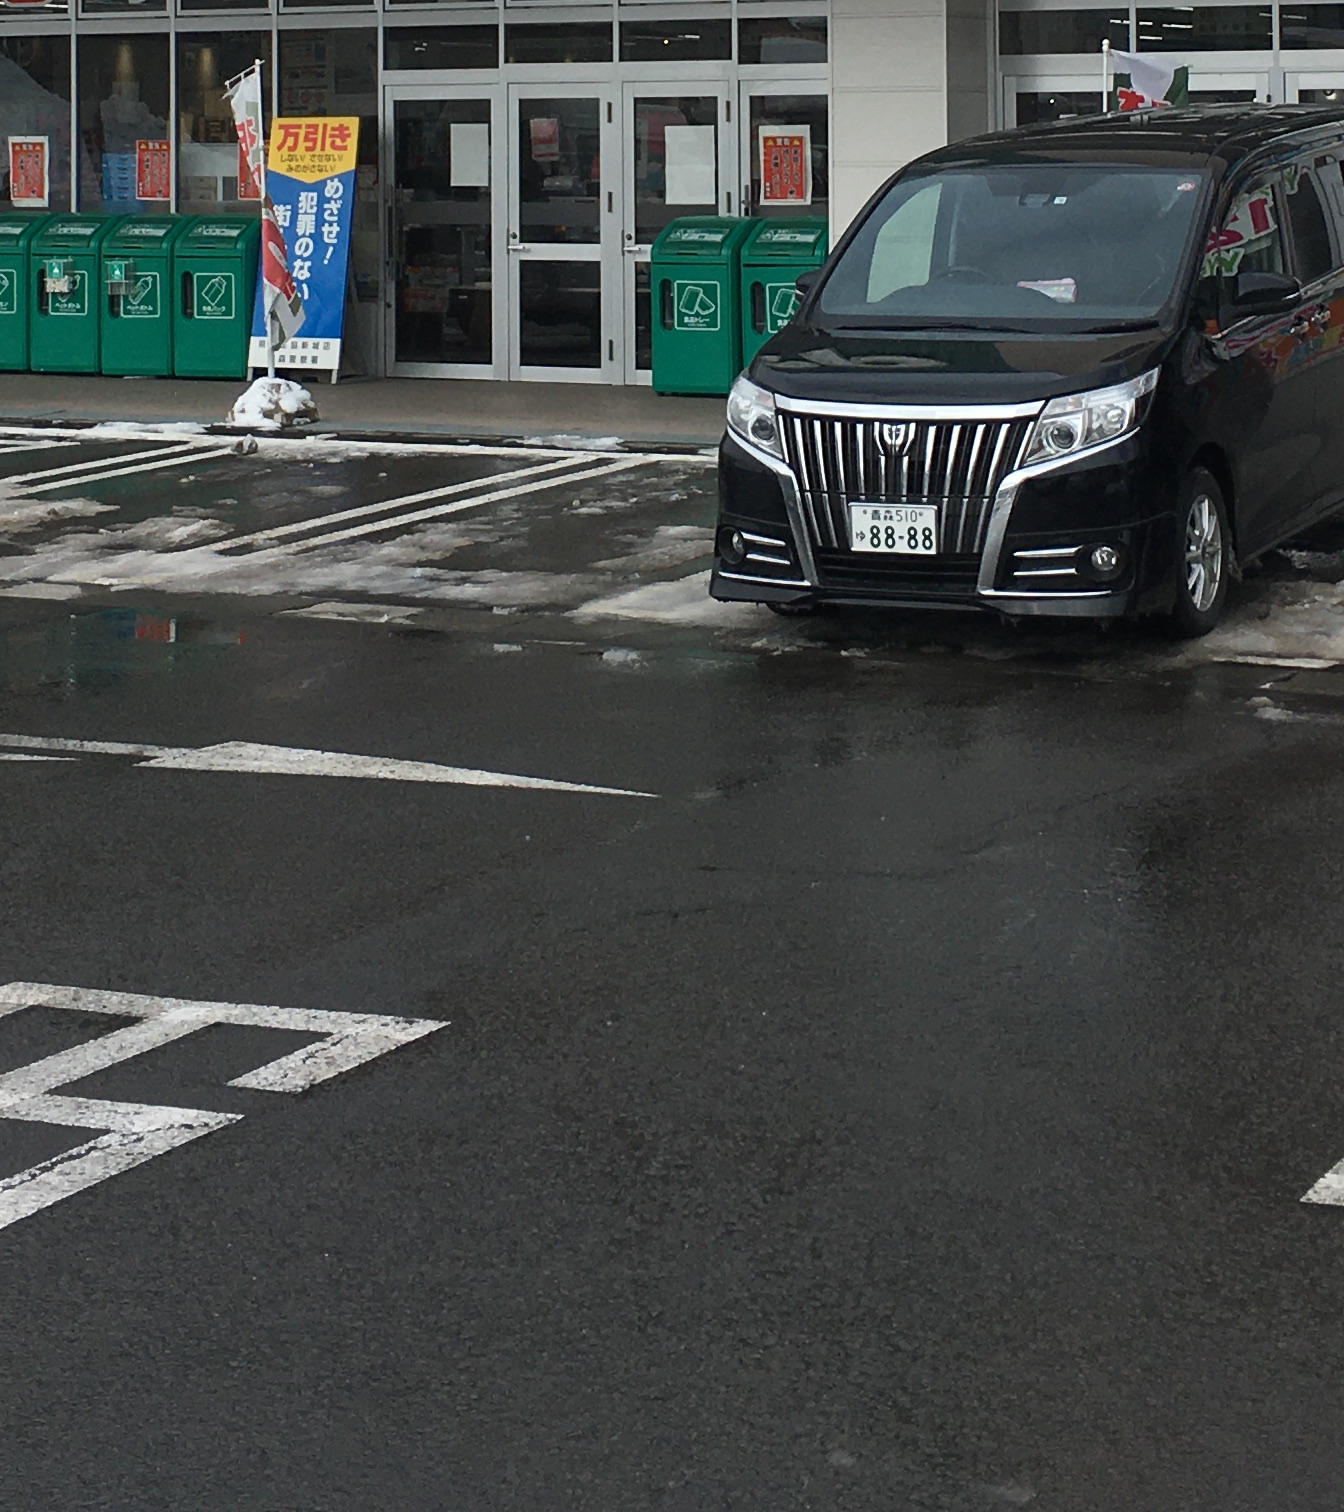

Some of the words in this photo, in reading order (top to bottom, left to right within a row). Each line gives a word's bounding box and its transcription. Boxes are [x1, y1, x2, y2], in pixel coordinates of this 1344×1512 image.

[276, 123, 352, 152] 万引き
[321, 177, 344, 265] めざせ!
[869, 525, 933, 550] 88-88
